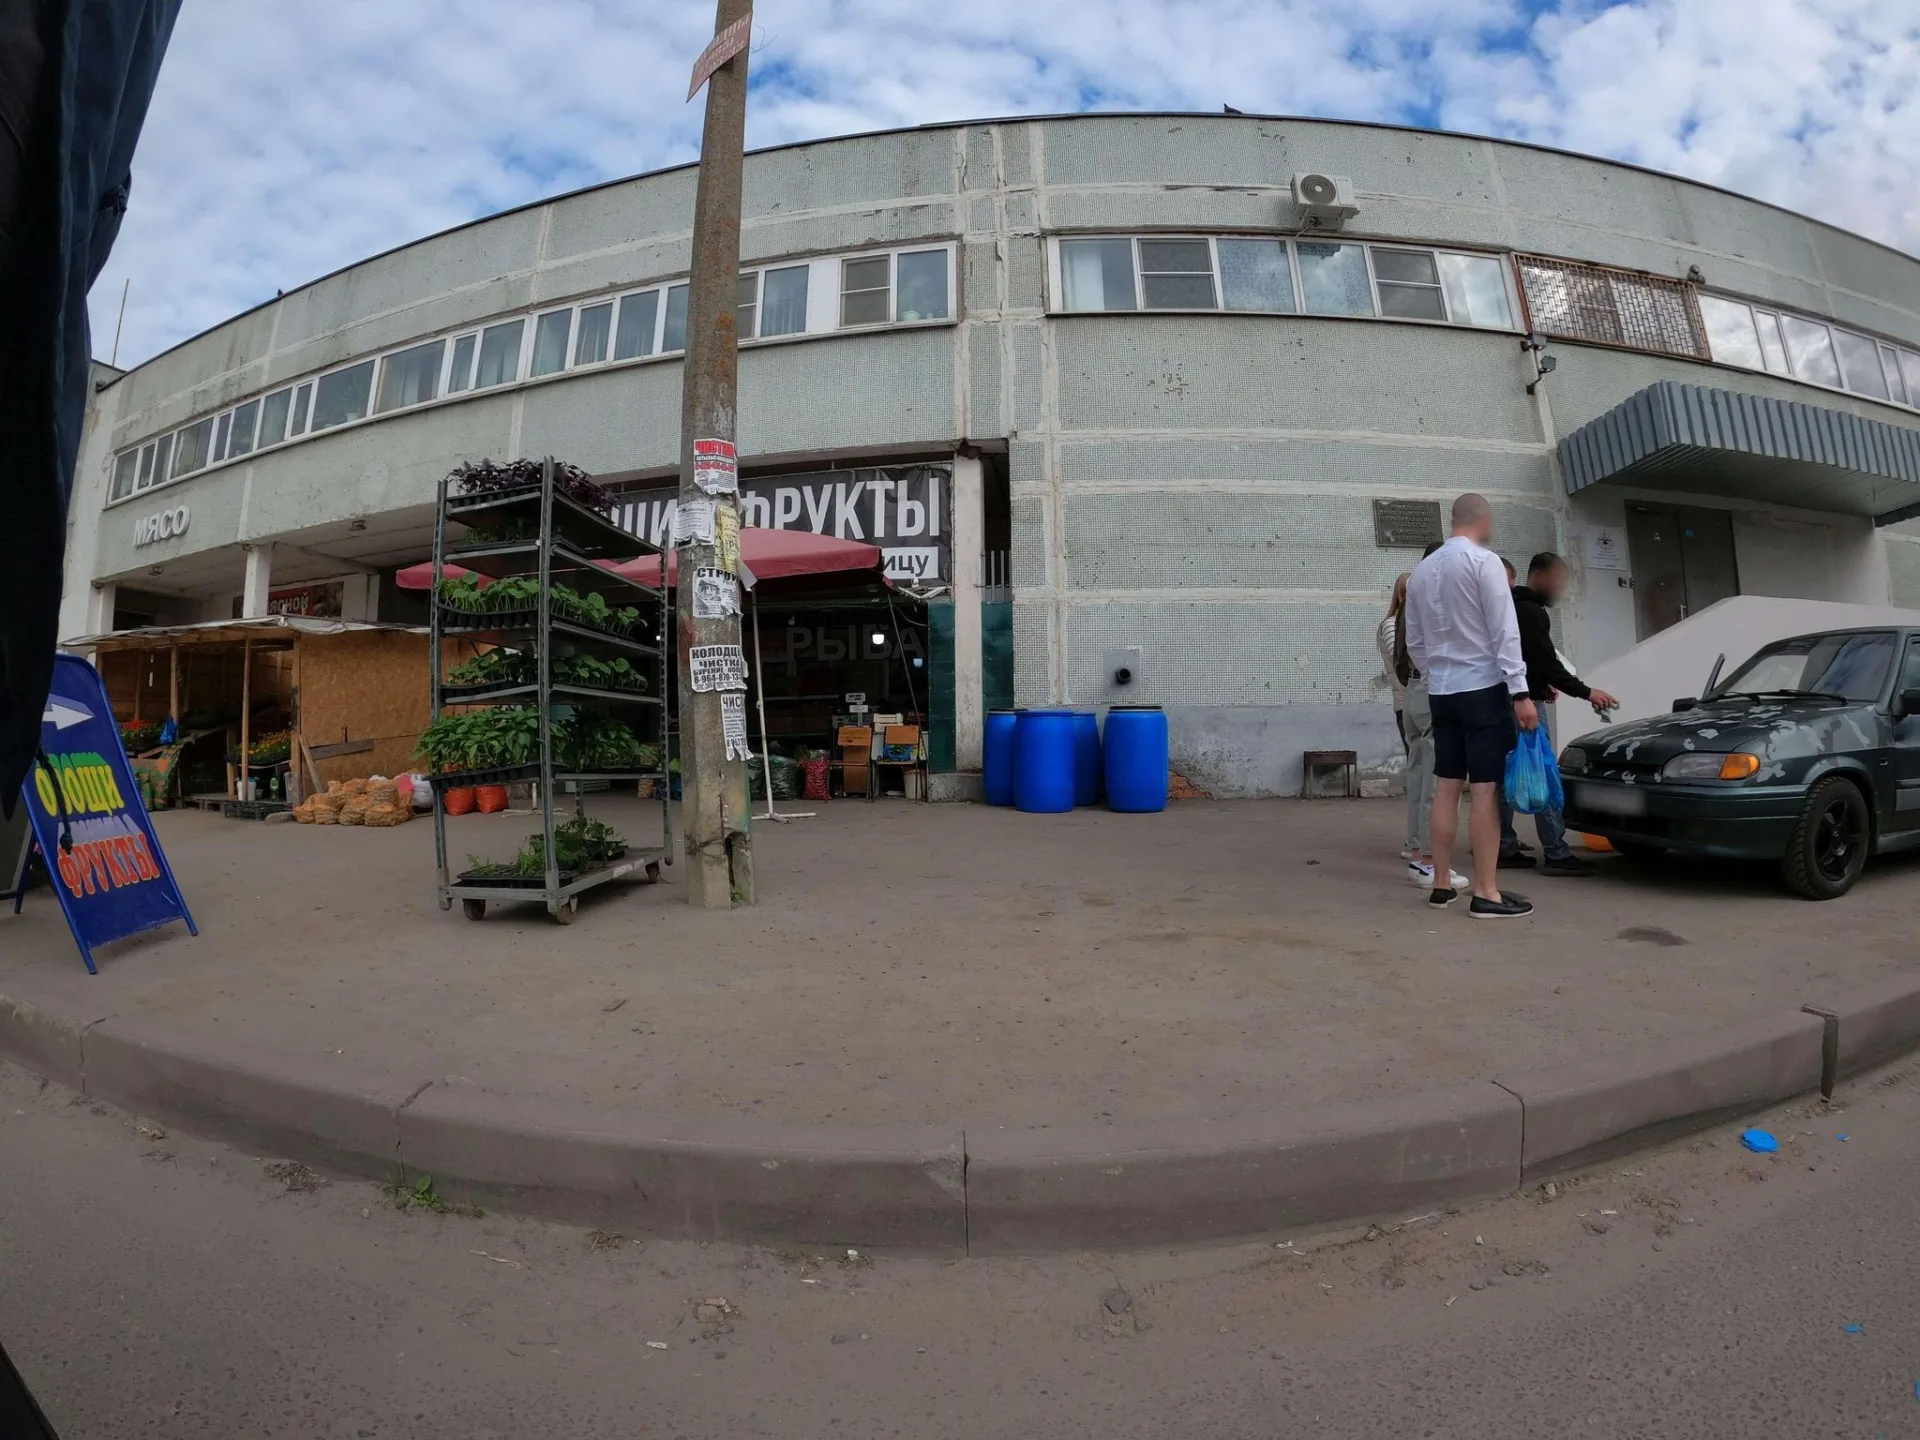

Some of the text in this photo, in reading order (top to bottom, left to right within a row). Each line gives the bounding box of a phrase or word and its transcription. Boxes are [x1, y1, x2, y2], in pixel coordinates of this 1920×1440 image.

[132, 505, 191, 547] МЯСО
[267, 591, 309, 613] ЯСНОЙ
[784, 623, 926, 662] РЫБА
[57, 832, 160, 898] ФРУКТЫ
